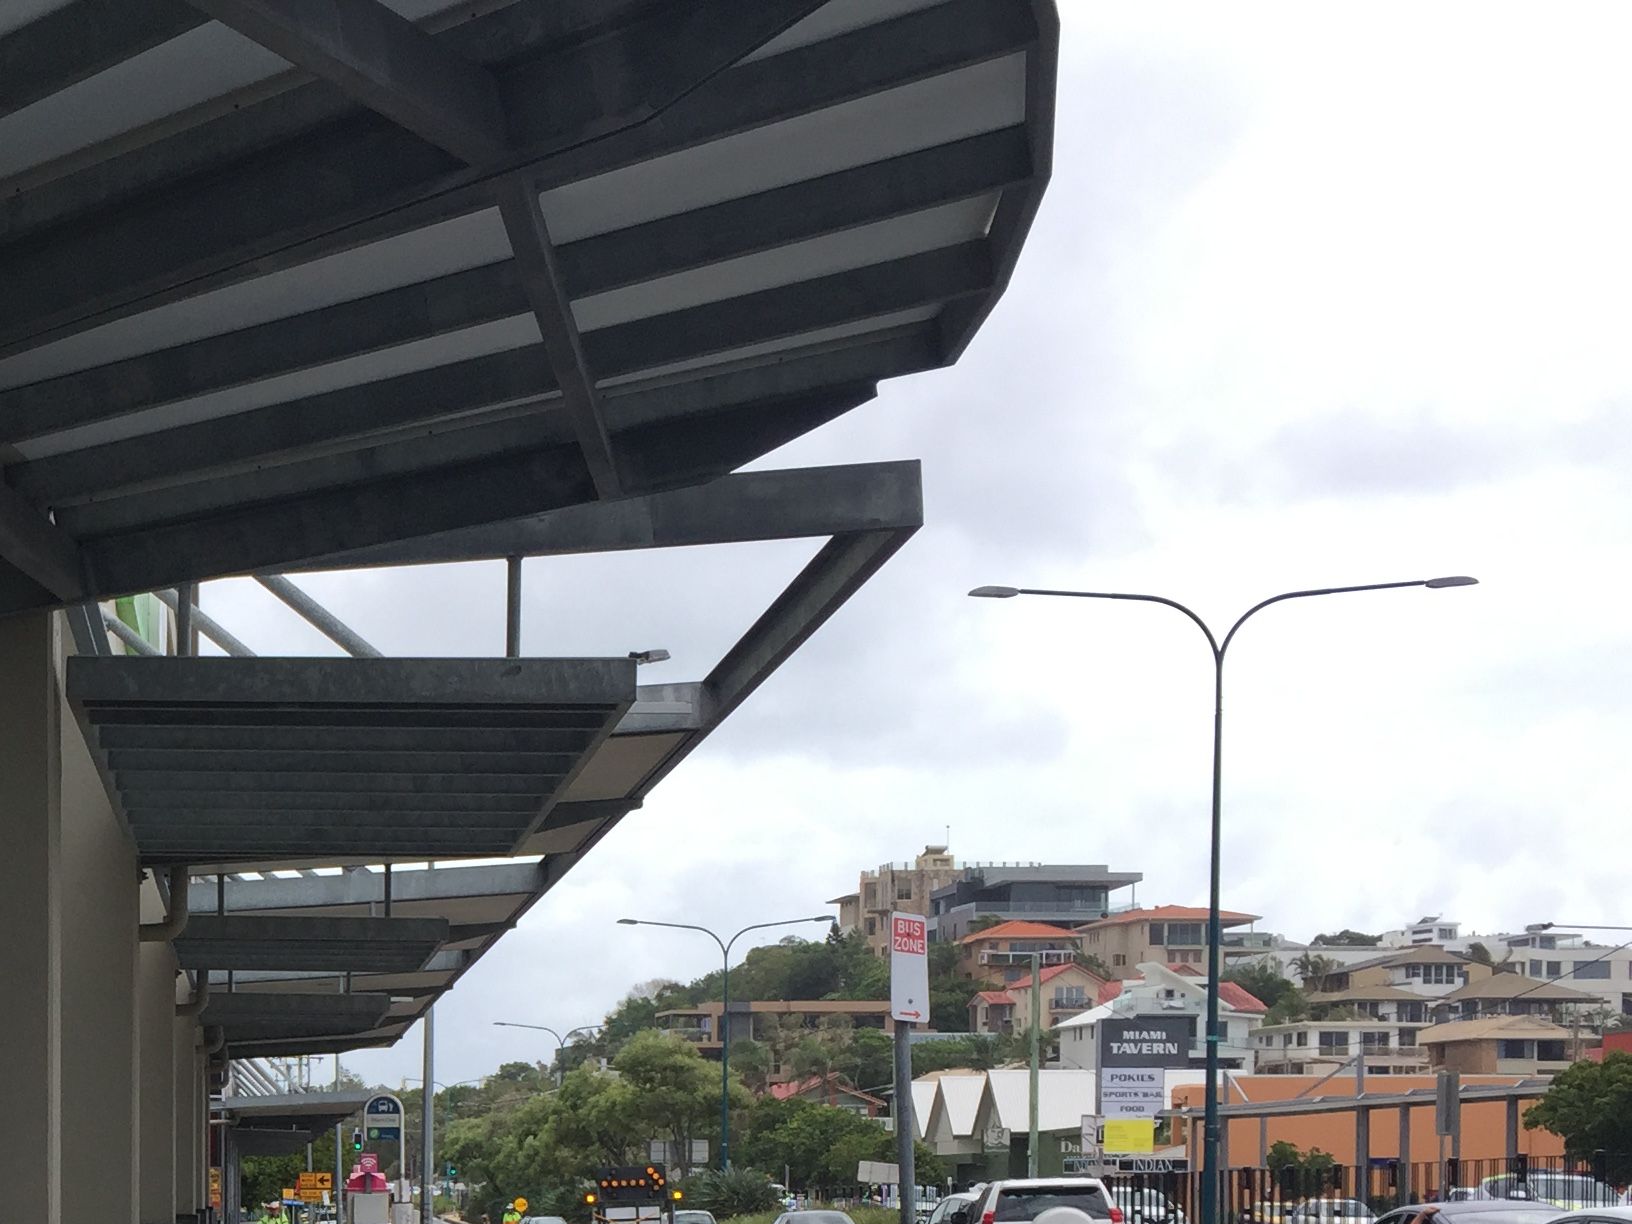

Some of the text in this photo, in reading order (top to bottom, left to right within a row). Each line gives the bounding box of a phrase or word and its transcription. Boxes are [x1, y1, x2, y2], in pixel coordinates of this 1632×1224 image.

[897, 920, 921, 936] BUS
[894, 937, 924, 953] ZONE
[1122, 1031, 1167, 1040] MIAMI
[1110, 1043, 1178, 1054] TAVERN
[1110, 1074, 1155, 1082] POKIES
[1133, 1160, 1173, 1171] INDIAN
